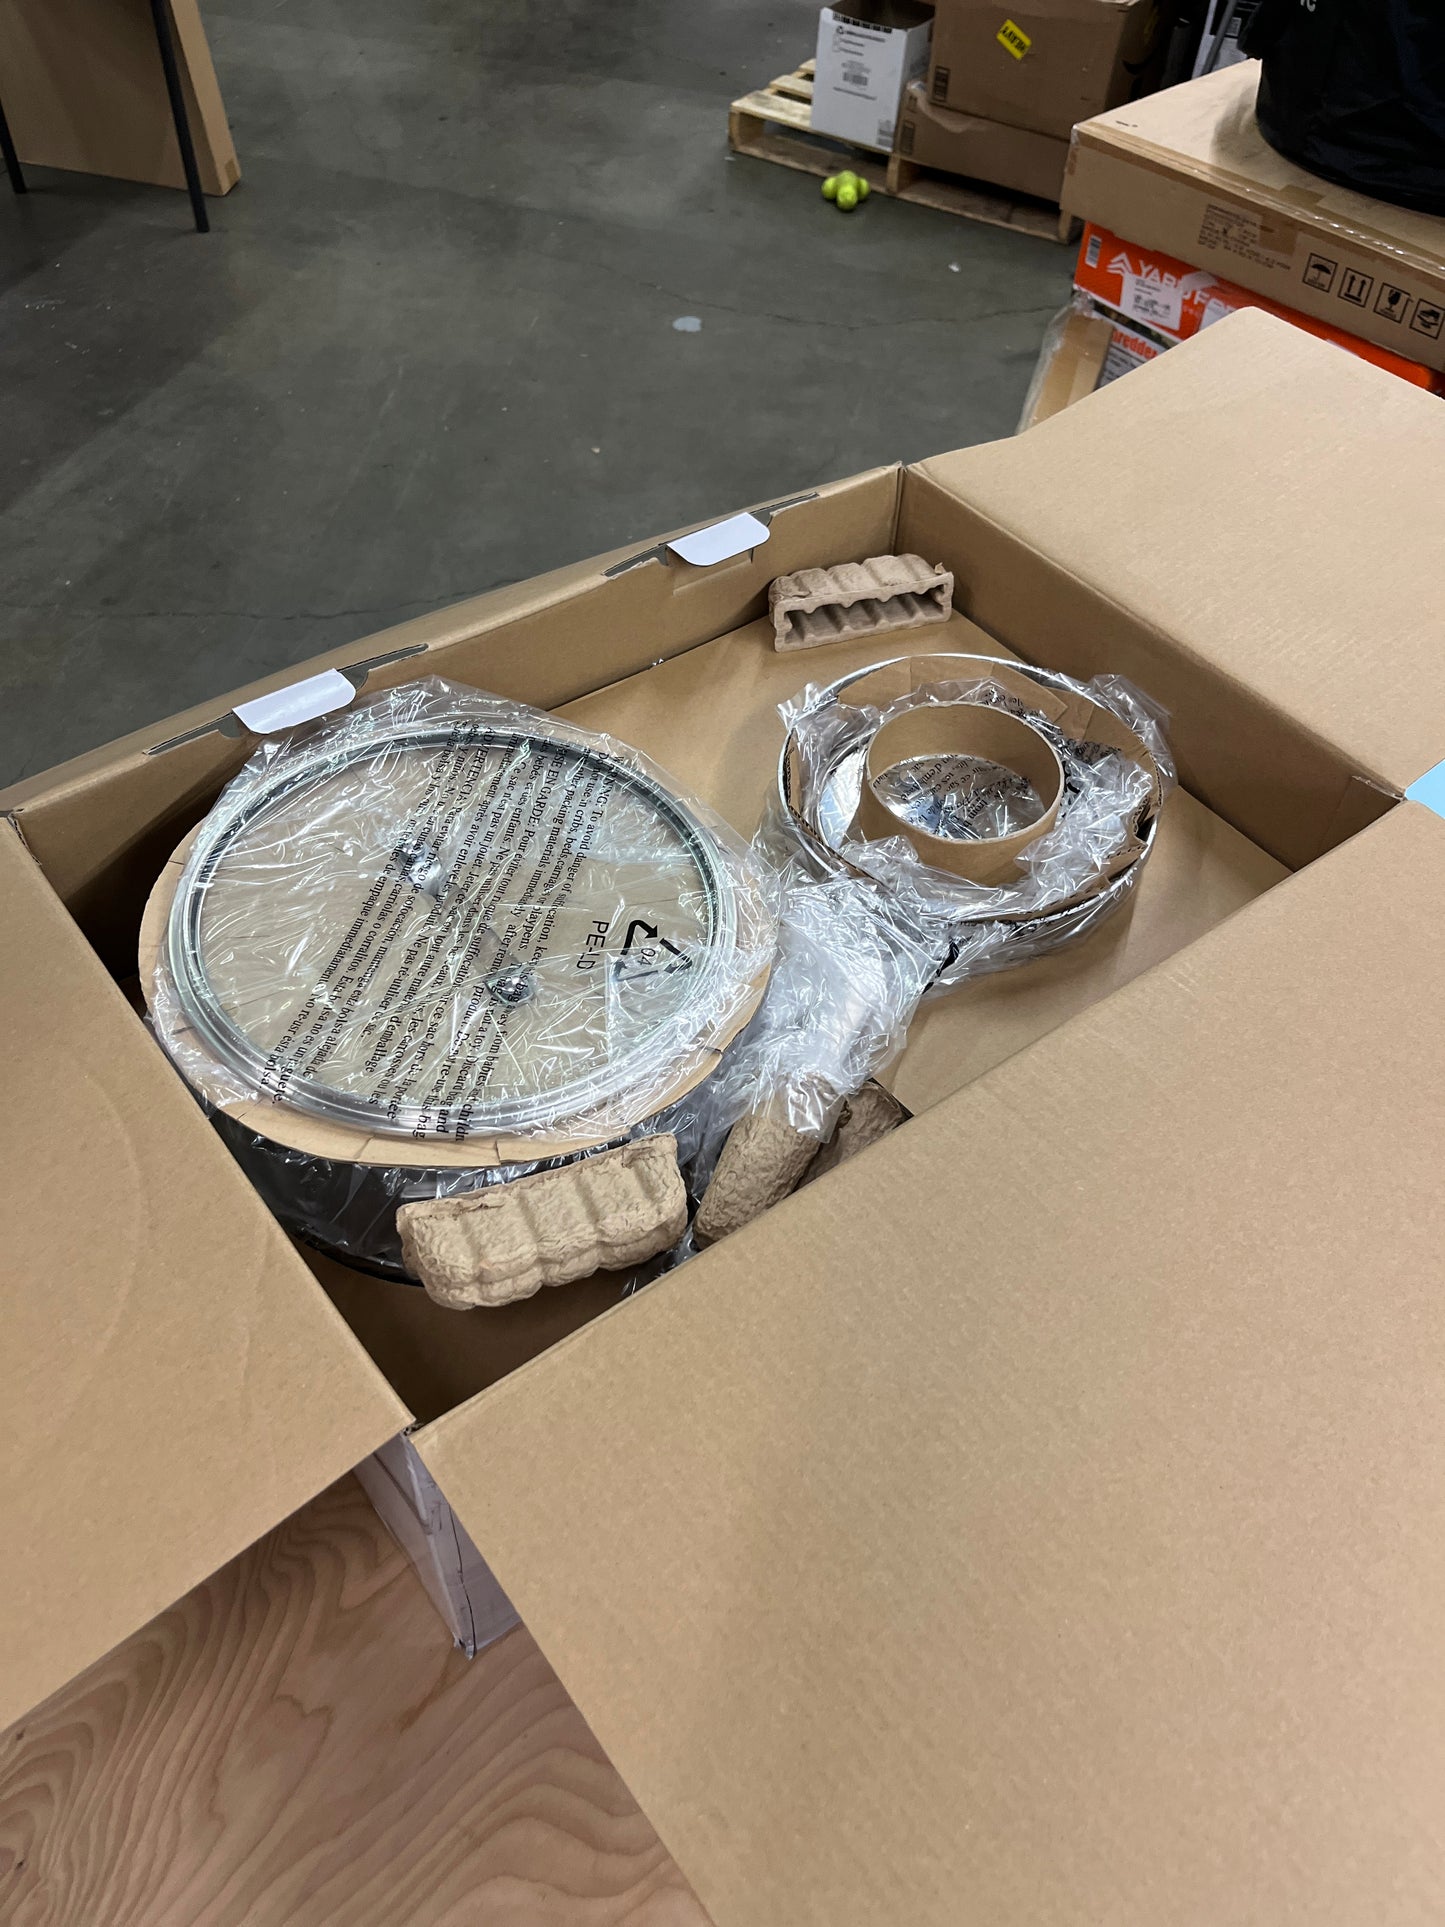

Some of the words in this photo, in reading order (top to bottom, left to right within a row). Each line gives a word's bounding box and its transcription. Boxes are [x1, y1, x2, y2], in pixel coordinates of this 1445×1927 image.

[436, 749, 456, 773] bolsa
[529, 756, 549, 780] bébés
[596, 752, 610, 764] Do
[447, 756, 467, 782] niños.
[545, 770, 561, 786] EN
[589, 766, 601, 781] not
[506, 775, 519, 790] sac
[583, 783, 595, 797] use
[474, 800, 491, 822] après
[497, 792, 514, 811] n'est
[527, 785, 554, 826] GARDE:
[552, 789, 575, 825] packing
[445, 807, 463, 823] Para
[490, 811, 503, 827] pas
[502, 808, 523, 842] enfants.
[566, 809, 585, 833] cribs,
[589, 810, 604, 822] To
[389, 819, 418, 862] mteriales
[431, 825, 450, 849] evitar
[464, 824, 479, 846] avoir
[484, 829, 495, 841] un
[517, 829, 536, 851] Pour
[579, 824, 595, 851] avoid
[472, 843, 489, 868] jouet.
[495, 847, 511, 860] Ne
[538, 827, 561, 867] materials
[383, 864, 398, 874] de
[416, 852, 438, 880] riesgo
[448, 849, 469, 881] enlevé
[505, 854, 526, 875] éviter
[567, 852, 589, 880] danger
[411, 883, 426, 893] de
[442, 880, 458, 892] les
[461, 872, 480, 891] Jeter
[473, 877, 494, 904] utiliser
[496, 878, 512, 894] tout
[561, 882, 574, 892] of
[360, 876, 388, 916] empaque
[455, 893, 466, 904] ce
[509, 869, 547, 916] immediatly
[380, 895, 415, 942] sofocación,
[462, 907, 482, 928] dans
[477, 922, 492, 933] de
[413, 934, 430, 947] Ne
[429, 934, 447, 953] tout
[455, 930, 471, 943] les
[501, 924, 518, 945] after
[345, 930, 377, 972] corralitos.
[576, 920, 609, 970] PE-LD
[404, 948, 418, 965] pas
[417, 954, 435, 977] autre
[638, 947, 656, 966] 04
[357, 946, 387, 988] mantenga
[333, 975, 353, 992] Esta
[378, 966, 411, 1009] ré-utiliser
[506, 984, 527, 1003] bag
[346, 990, 362, 1005] esta
[461, 986, 485, 1026] product.
[287, 1010, 308, 1033] re-usr
[331, 1007, 353, 1033] bolsa
[433, 1006, 444, 1018] ce
[310, 1023, 322, 1034] no
[361, 1023, 376, 1037] sac.
[407, 1017, 423, 1032] les
[425, 1021, 439, 1039] sac
[274, 1035, 296, 1052] ésta
[302, 1035, 315, 1045] es
[364, 1016, 403, 1072] d'emballage
[454, 1032, 470, 1045] Do
[469, 1035, 486, 1051] toy.
[490, 1030, 508, 1053] from
[294, 1047, 306, 1057] un
[310, 1036, 337, 1064] alejada
[415, 1041, 434, 1060] hors
[259, 1055, 282, 1087] bolsa.
[431, 1064, 450, 1092] re-use
[452, 1055, 479, 1092] Discard
[476, 1057, 498, 1086] babies
[377, 1079, 390, 1088] ou
[402, 1078, 416, 1086] la
[368, 1091, 385, 1104] les
[386, 1086, 407, 1118] portée
[422, 1095, 437, 1109] this
[436, 1109, 448, 1133] and
